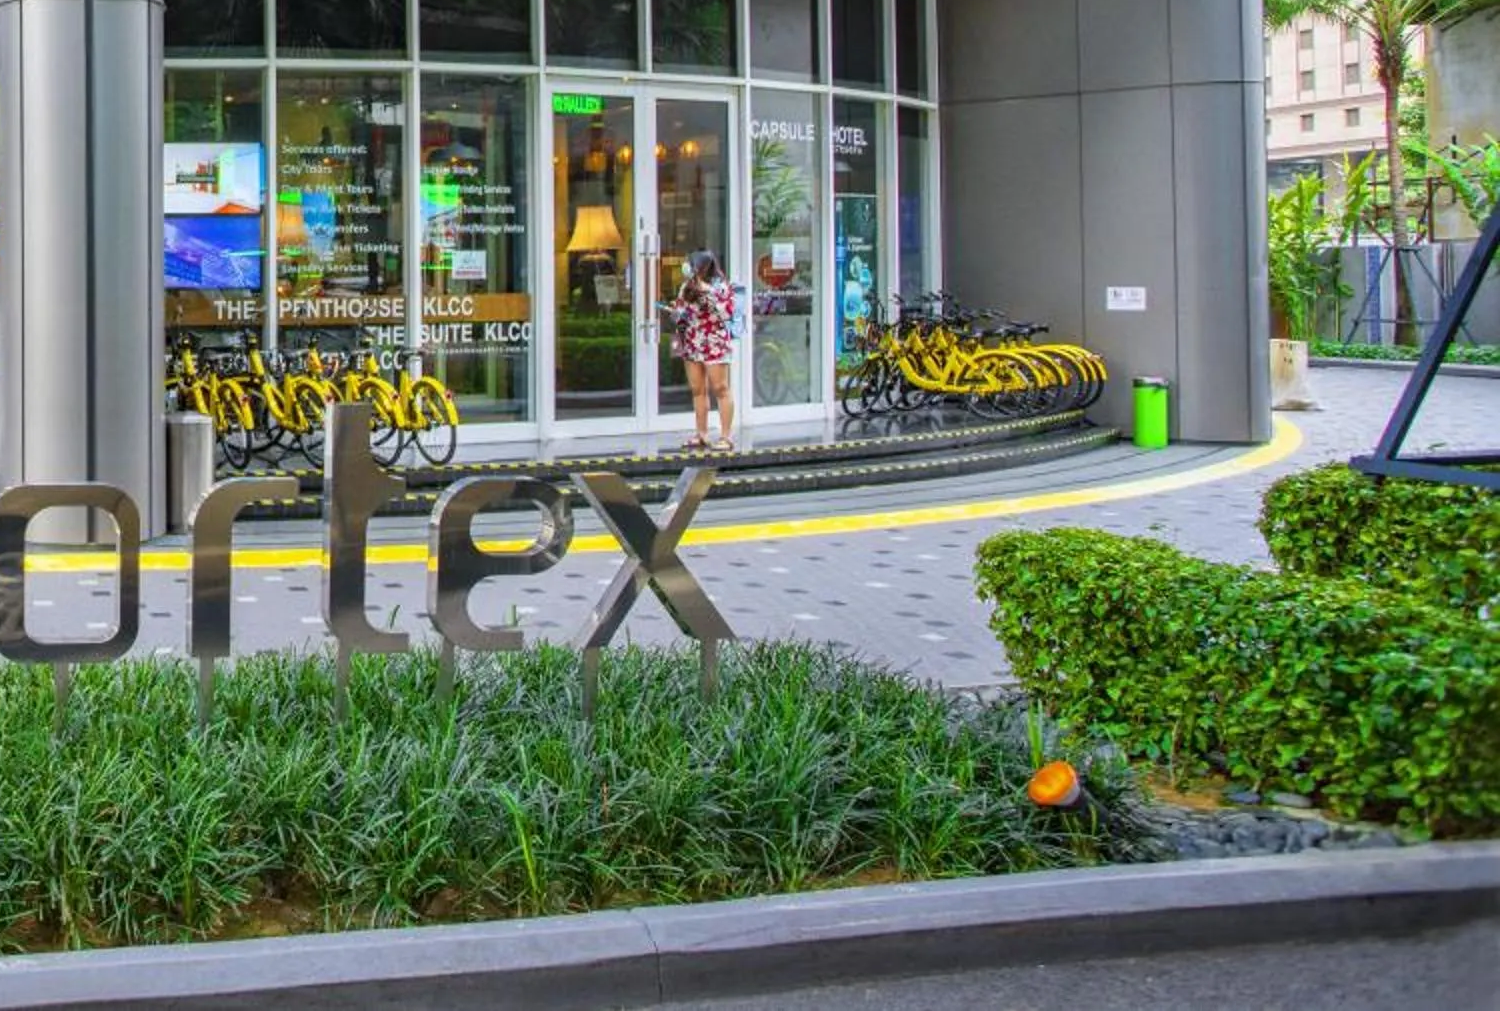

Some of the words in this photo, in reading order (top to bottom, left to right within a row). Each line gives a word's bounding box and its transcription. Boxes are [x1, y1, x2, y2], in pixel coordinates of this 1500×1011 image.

[750, 120, 815, 141] CAPSULE
[281, 144, 324, 154] Services
[281, 164, 302, 176] City
[347, 184, 374, 194] Tours
[354, 243, 400, 255] Ticketing
[214, 300, 256, 320] THE
[279, 298, 404, 319] PENTHOUSE
[423, 296, 474, 316] KLCC
[365, 325, 405, 345] THE
[419, 322, 473, 343] SUITE
